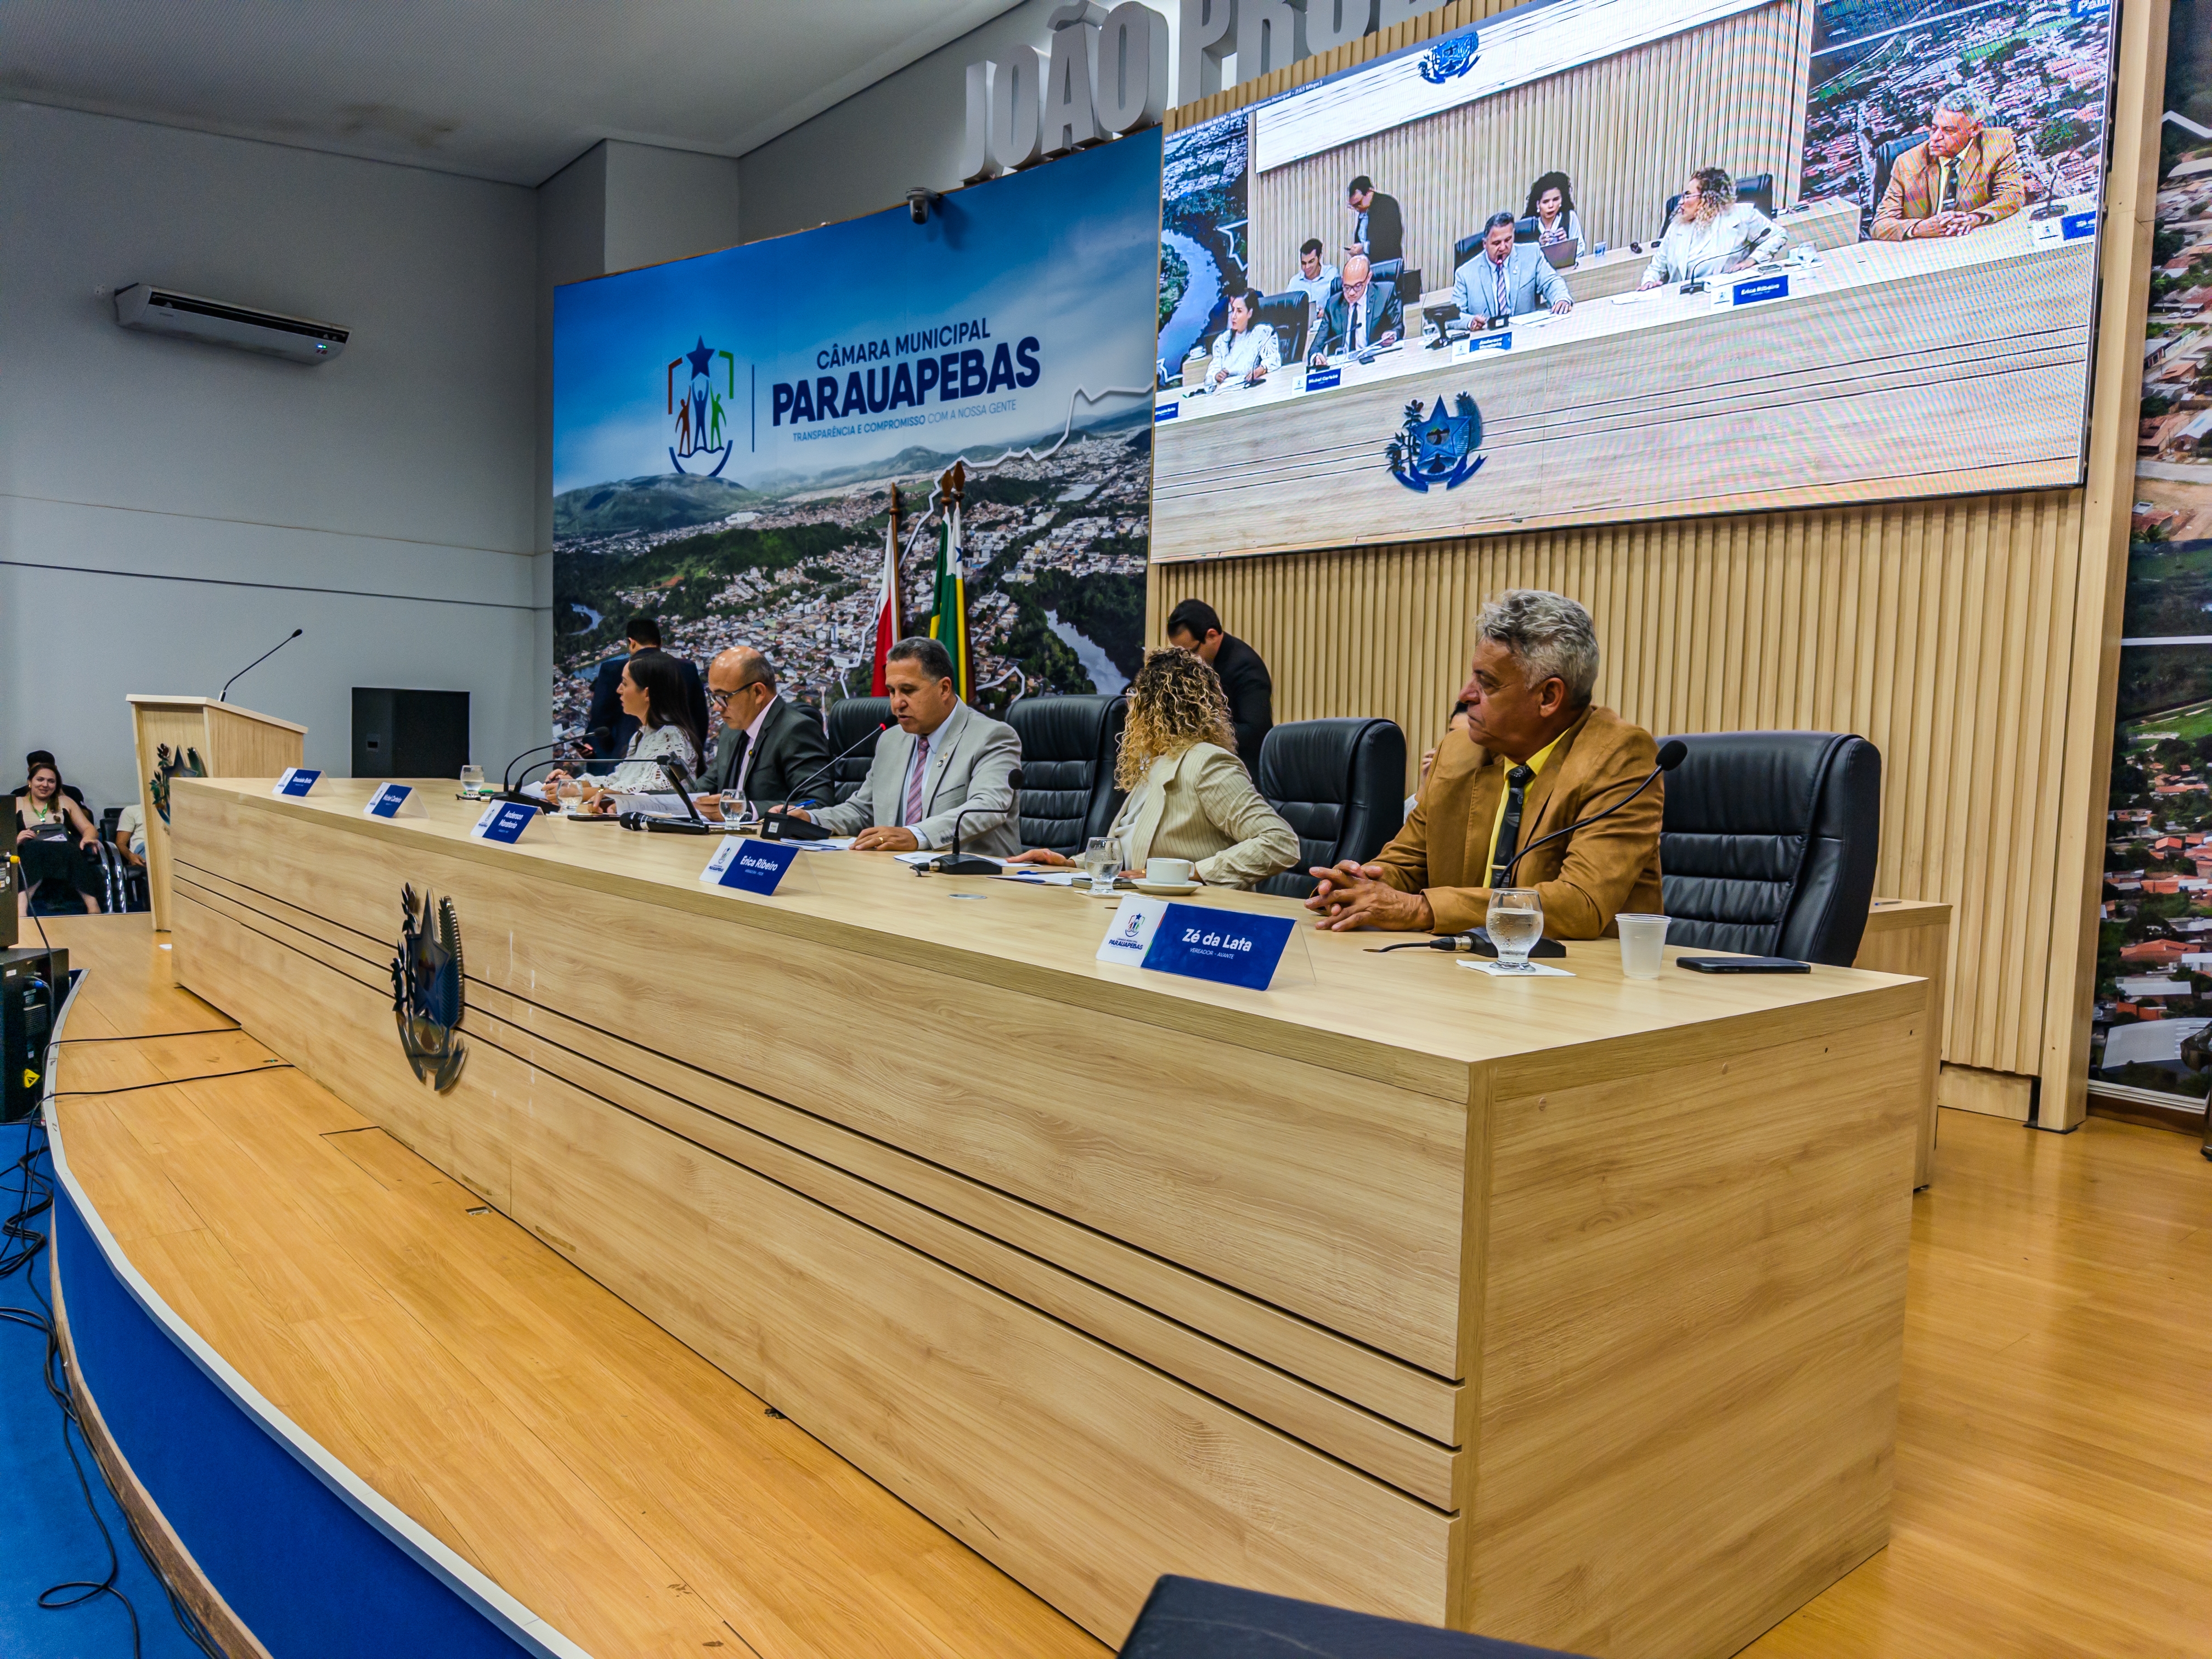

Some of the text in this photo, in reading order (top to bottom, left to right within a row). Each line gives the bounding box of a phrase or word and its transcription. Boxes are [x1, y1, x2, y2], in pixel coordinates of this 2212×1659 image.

[959, 0, 1158, 182] JOÃO
[816, 317, 991, 370] CÂMARA MUNICIPAL
[772, 336, 1041, 427] PARAUAPEBAS
[793, 399, 1017, 442] TRANSPARÊNCIA E COMPROMISSO COM A NOSSA GENTE
[740, 855, 778, 871] Erica Ribeiro
[1108, 939, 1143, 950] PARAUAPEBAS
[1182, 928, 1252, 952] Zé da Lata
